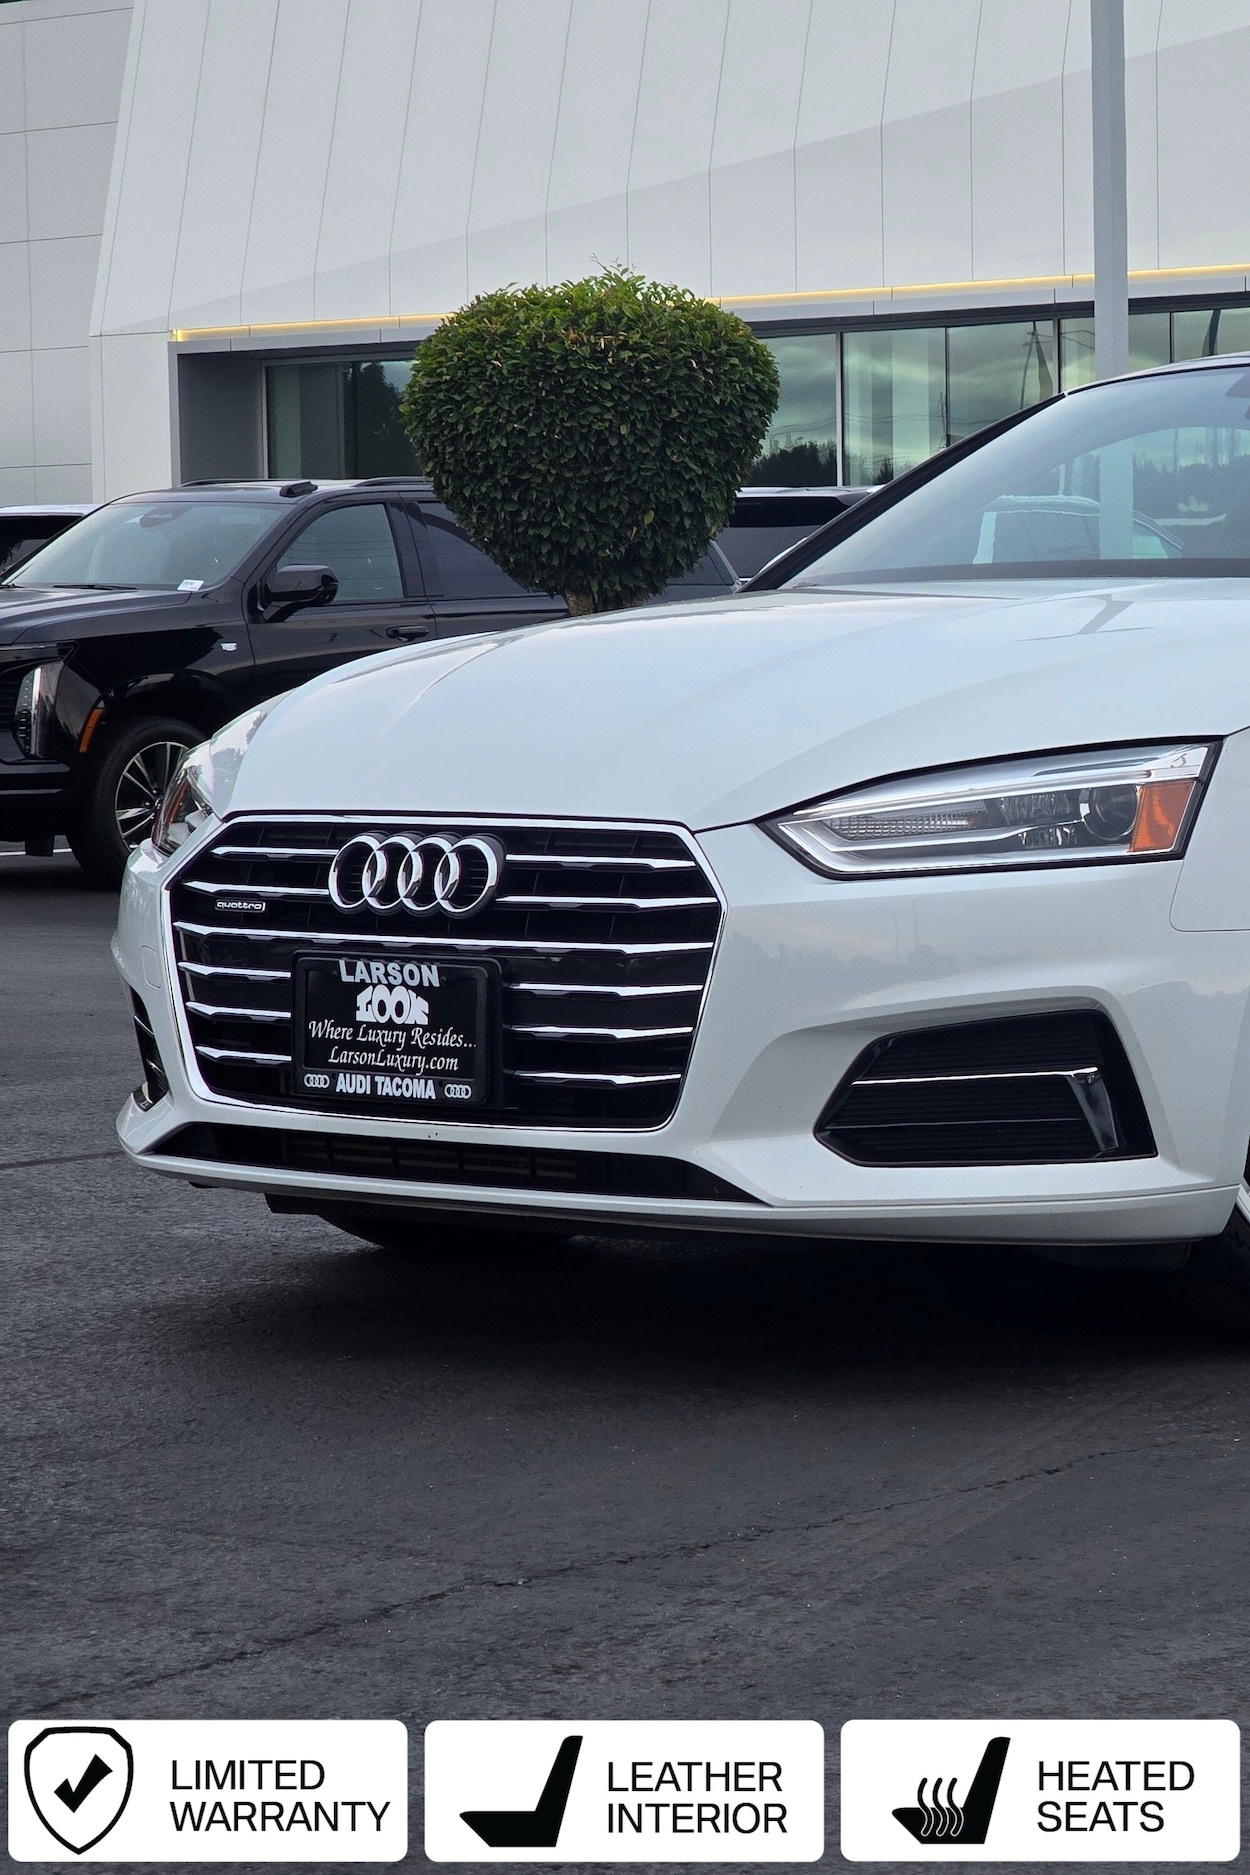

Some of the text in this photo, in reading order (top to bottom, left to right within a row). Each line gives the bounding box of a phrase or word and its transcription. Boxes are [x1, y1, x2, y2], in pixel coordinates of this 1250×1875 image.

[216, 901, 262, 910] quattro
[339, 959, 440, 987] LARSON
[308, 1019, 477, 1050] Where Luxury Resides...
[328, 1046, 459, 1076] LarsonLuxury.com
[336, 1073, 436, 1100] AUDI TACOMA
